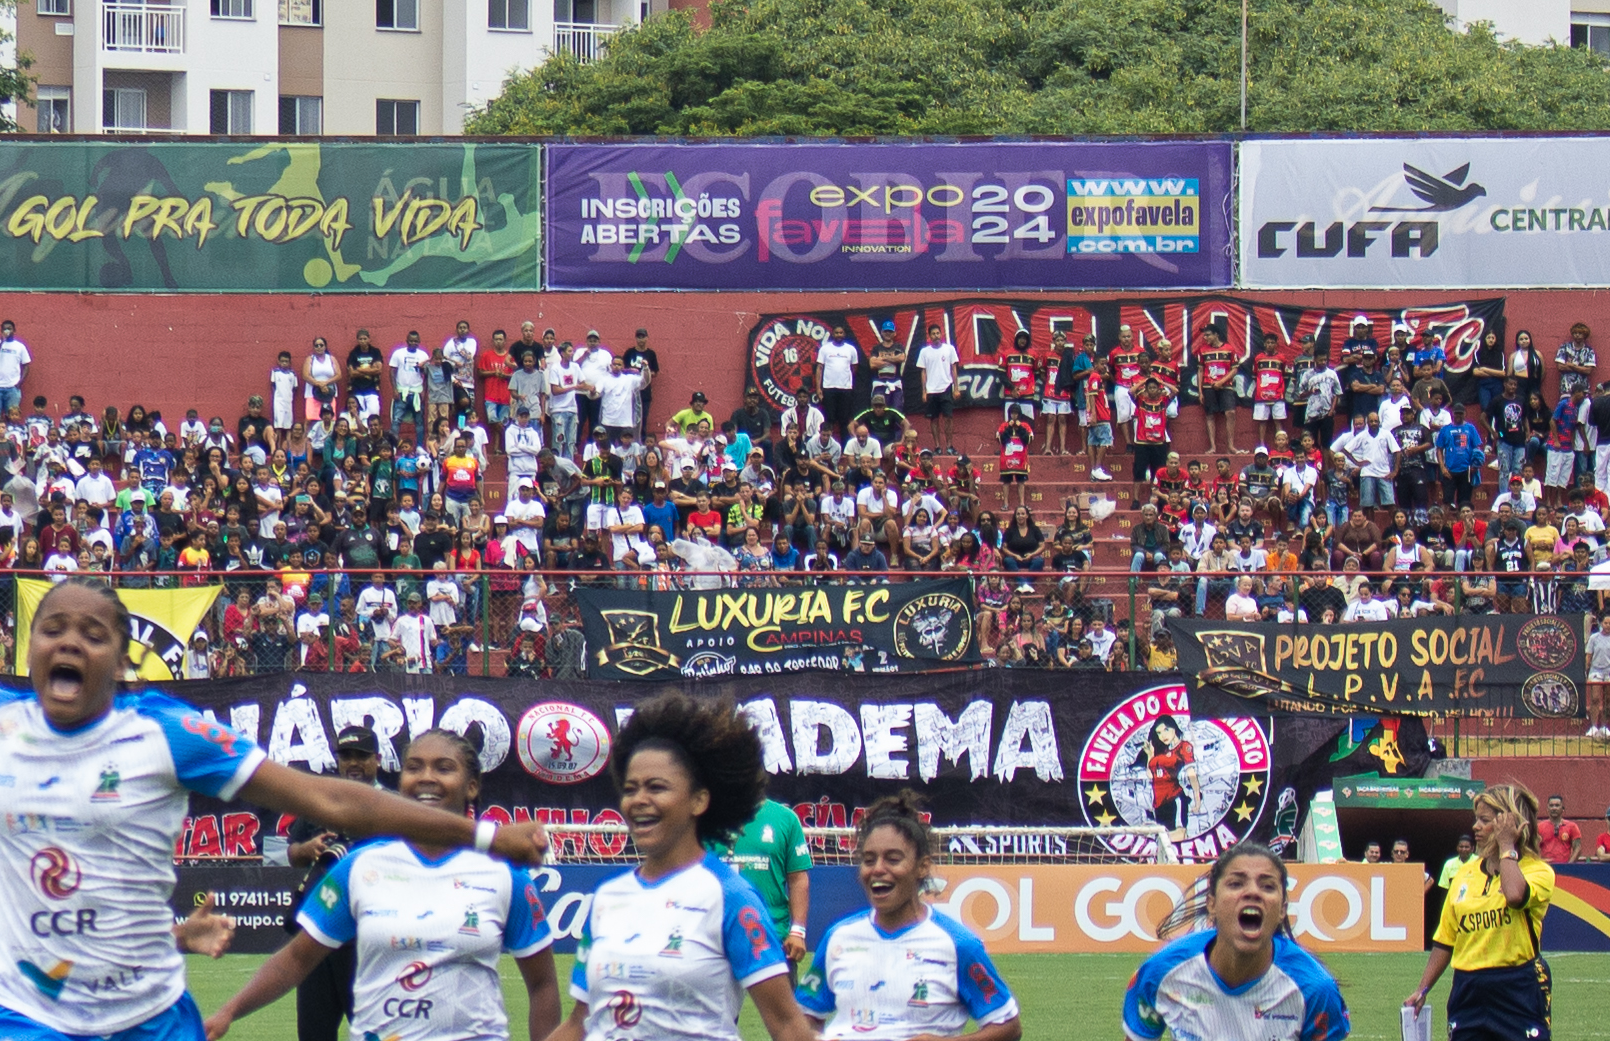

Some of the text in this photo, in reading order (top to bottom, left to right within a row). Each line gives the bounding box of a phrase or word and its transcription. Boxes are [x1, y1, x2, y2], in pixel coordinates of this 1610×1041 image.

[809, 184, 964, 214] expo
[971, 185, 1054, 213] 20
[1071, 180, 1194, 196] www.
[7, 194, 104, 243] GOL
[121, 195, 218, 249] PRA
[232, 195, 354, 251] TODA
[372, 189, 483, 252] VIDA
[581, 193, 740, 223] INSCRIÇÕES
[1071, 199, 1193, 233] expofavela
[581, 224, 740, 244] ABERTAS
[971, 216, 1055, 243] 24
[1070, 236, 1195, 252] .com.br
[1257, 221, 1439, 258] CUFA
[841, 245, 912, 253] INNOVATION
[755, 318, 832, 368] VIDA NOV
[669, 589, 890, 634] LUXURIA F.C
[898, 596, 962, 625] LUXURIA
[686, 636, 735, 649] APOIO
[1275, 624, 1516, 673] PROJETO SOCIAL
[1087, 712, 1134, 773] FAVELA
[1132, 696, 1160, 721] DO
[30, 908, 99, 938] CCR
[384, 997, 435, 1021] CCR
